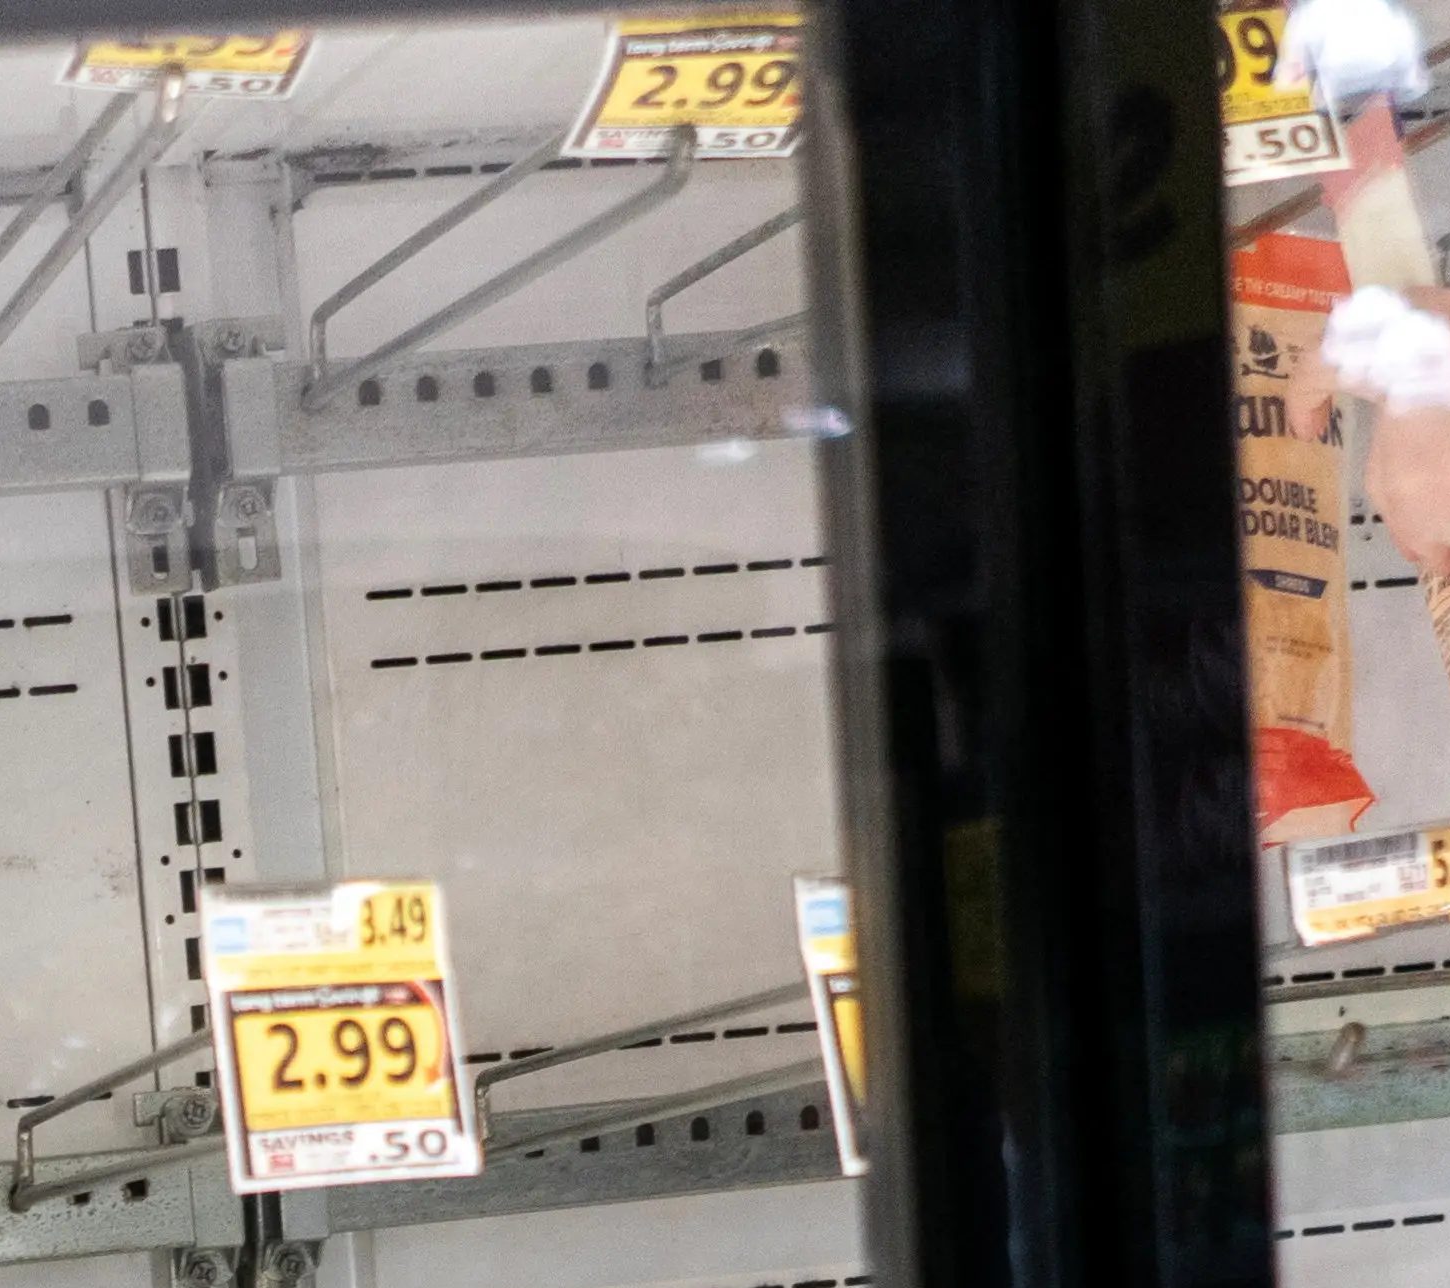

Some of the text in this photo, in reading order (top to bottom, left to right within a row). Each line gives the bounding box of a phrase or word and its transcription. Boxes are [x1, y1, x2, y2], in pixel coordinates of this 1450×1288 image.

[632, 60, 795, 109] 2.99
[1246, 124, 1320, 161] .50
[363, 895, 425, 947] 3.49
[267, 1016, 417, 1091] 2.99
[369, 1128, 448, 1163] .50
